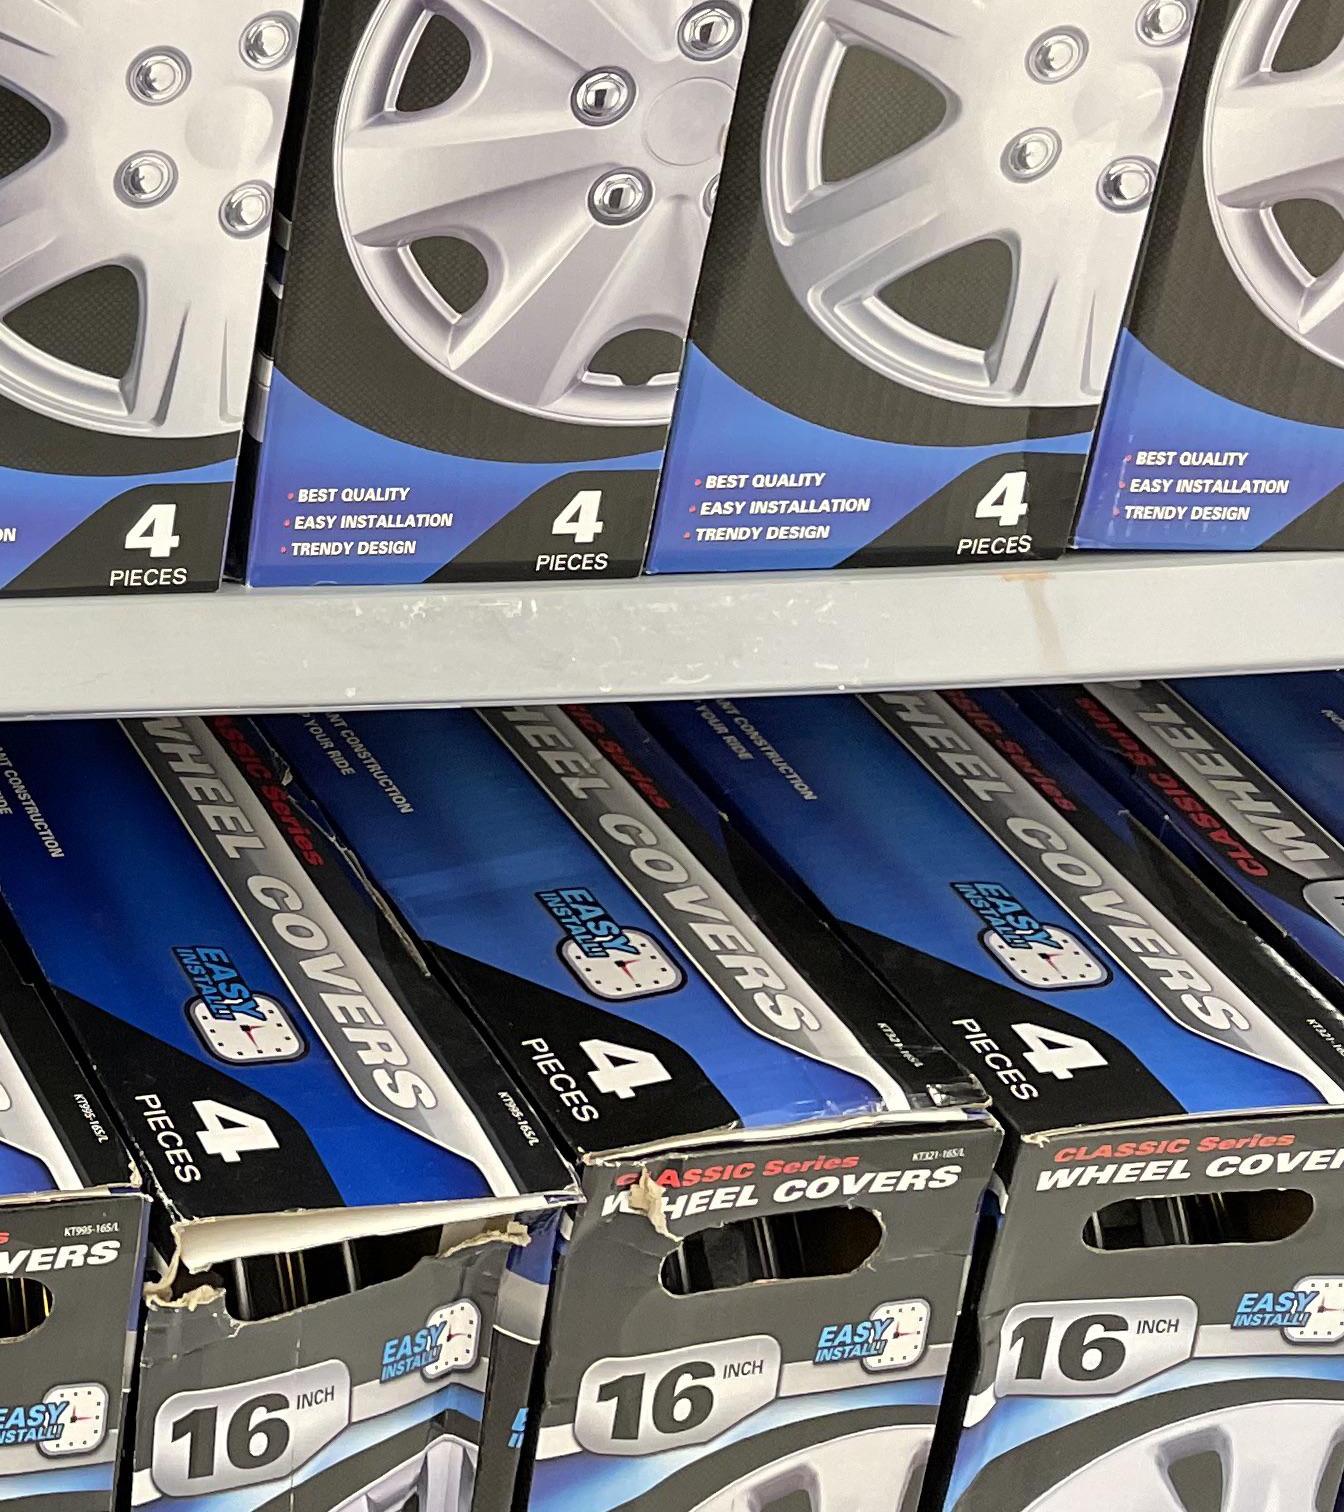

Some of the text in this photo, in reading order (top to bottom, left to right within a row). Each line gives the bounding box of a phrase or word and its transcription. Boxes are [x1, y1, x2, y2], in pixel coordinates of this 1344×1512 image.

[705, 471, 825, 489] BEST QUALITY
[700, 496, 870, 516] EASY INSTALLATION
[974, 471, 1027, 526] 4
[696, 524, 830, 543] TRENDY DESIGN
[956, 534, 1032, 556] PIECES
[952, 1017, 1038, 1103] PIECES
[1054, 1133, 1295, 1164] CLASSIC Series
[818, 1317, 893, 1349] EASY
[1009, 1314, 1180, 1380] 16 INCH
[170, 1385, 334, 1474] 16 INCH
